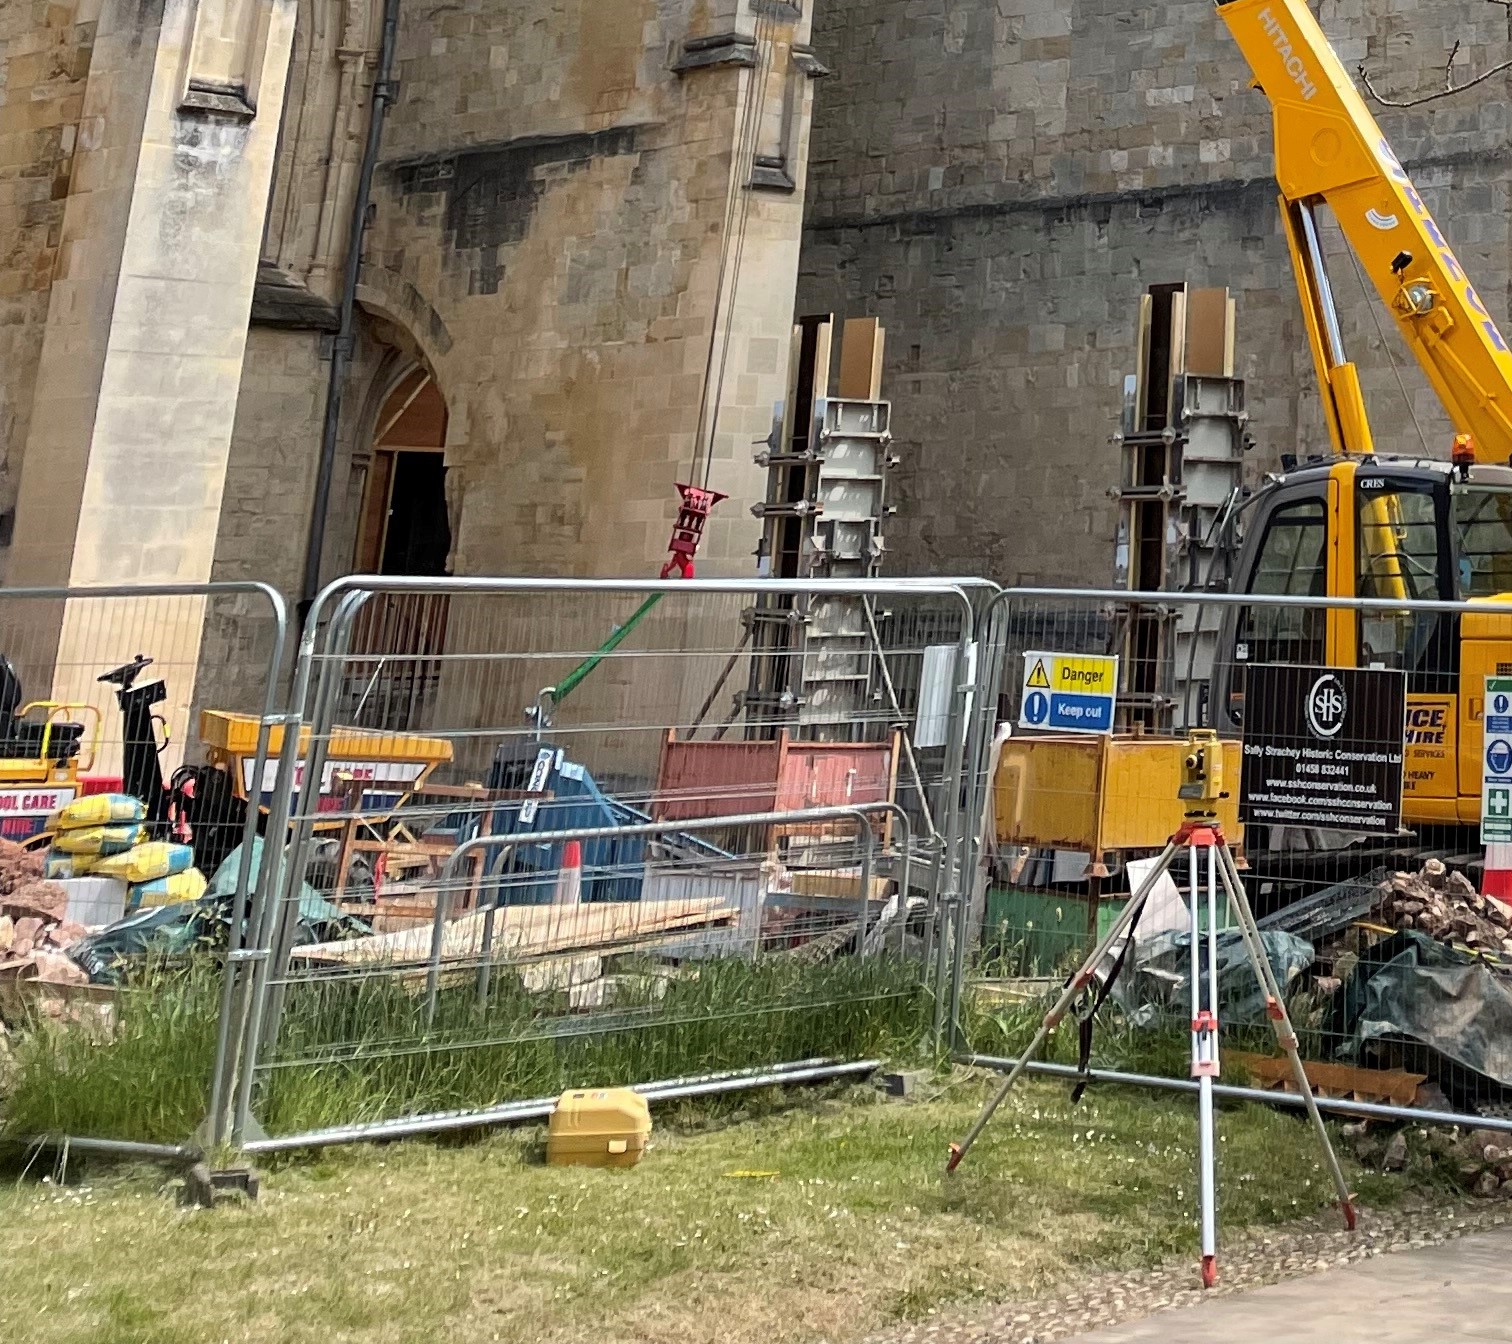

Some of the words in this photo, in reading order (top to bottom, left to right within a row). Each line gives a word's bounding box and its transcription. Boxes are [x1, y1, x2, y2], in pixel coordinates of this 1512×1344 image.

[1258, 7, 1318, 101] HITACHI
[1062, 667, 1104, 685] Danger
[1058, 703, 1083, 719] Keep
[1085, 706, 1102, 718] out
[1244, 744, 1264, 757] Sally
[1265, 746, 1301, 759] Strachey
[1302, 748, 1334, 759] Historic
[1334, 749, 1388, 762] Conservation
[1388, 753, 1402, 763] Ltd
[22, 794, 57, 810] CARE
